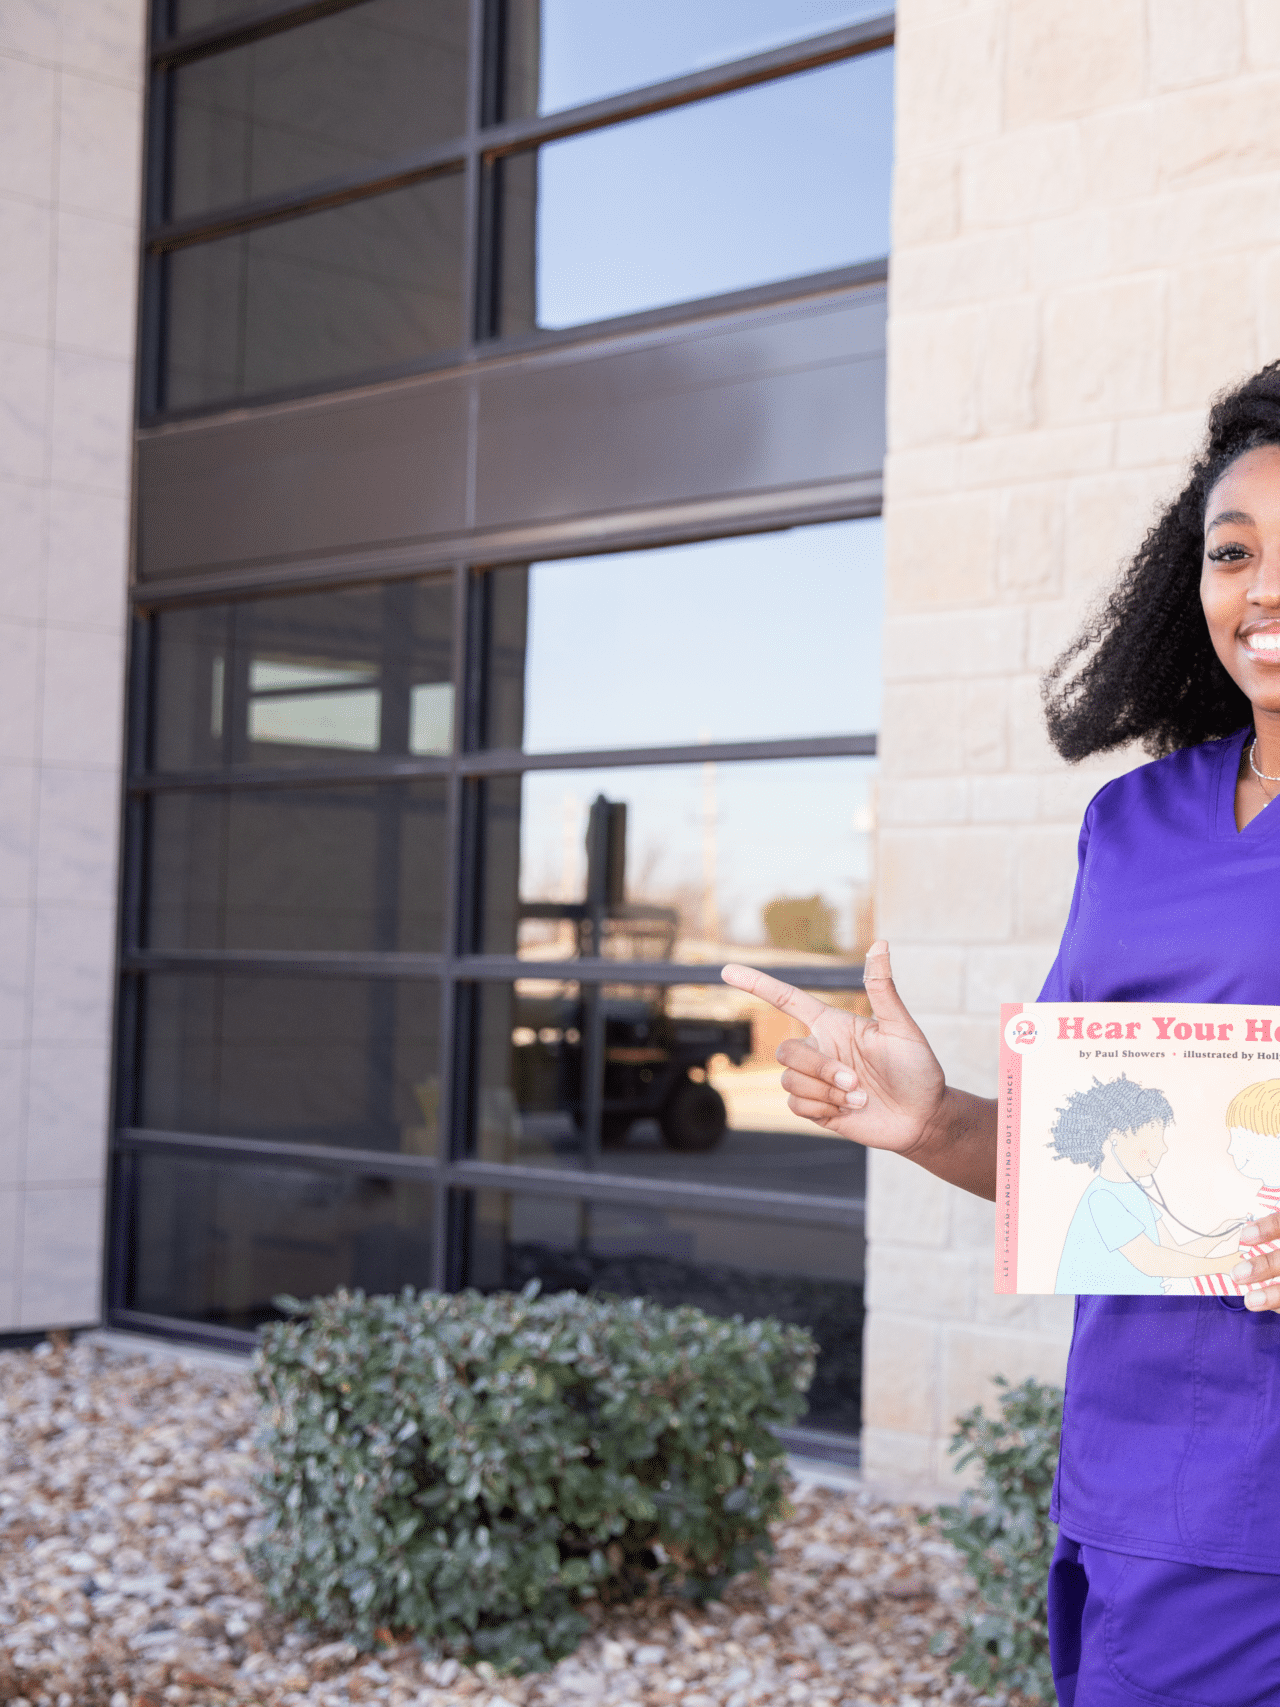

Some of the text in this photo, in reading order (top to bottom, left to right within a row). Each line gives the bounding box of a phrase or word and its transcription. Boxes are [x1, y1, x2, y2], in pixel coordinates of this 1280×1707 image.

[1015, 1020, 1036, 1045] 2
[1057, 1017, 1141, 1040] Hear
[1152, 1017, 1234, 1041] Your
[1079, 1050, 1166, 1060] by Paul Showers
[1183, 1050, 1238, 1059] illustrated
[1241, 1051, 1254, 1061] by
